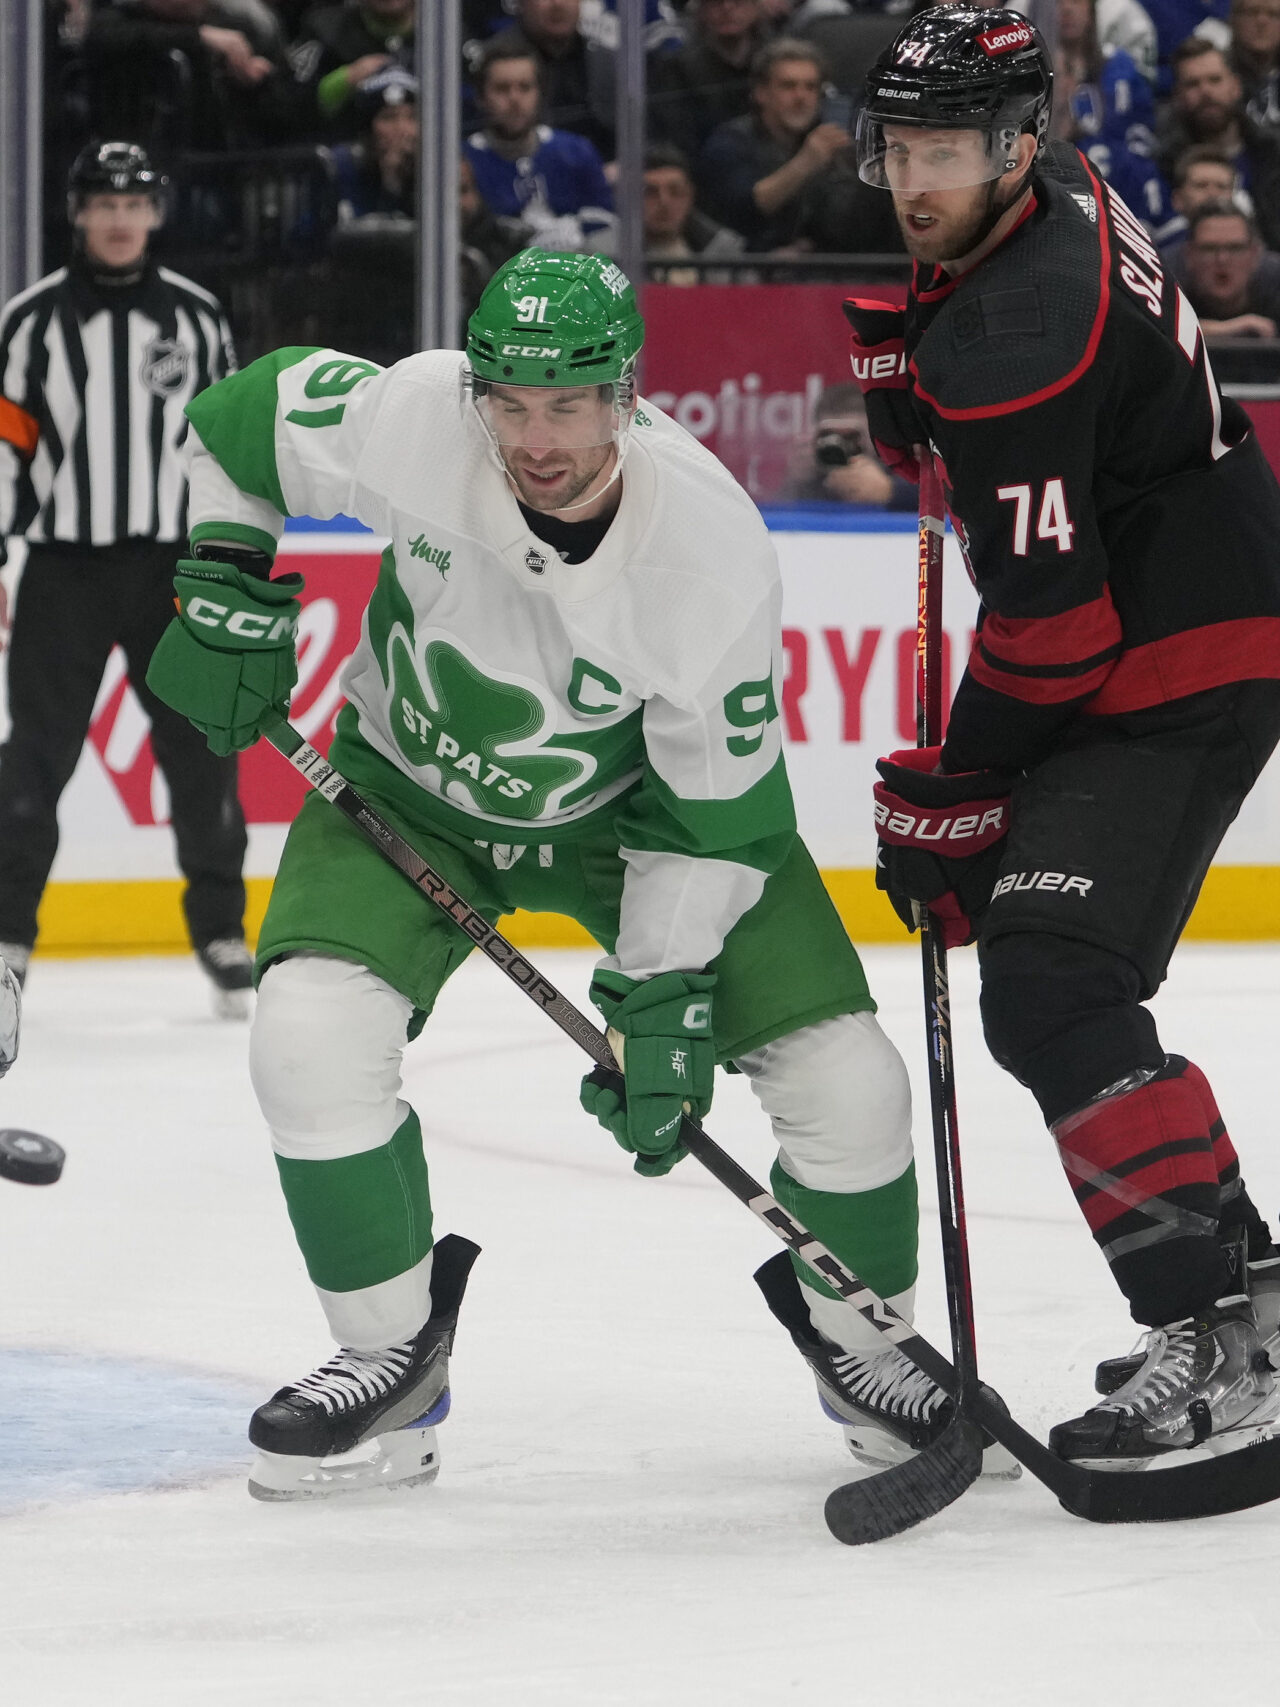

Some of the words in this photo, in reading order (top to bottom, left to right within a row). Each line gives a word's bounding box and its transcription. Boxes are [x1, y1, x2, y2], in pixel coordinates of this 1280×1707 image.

[896, 40, 934, 68] 74
[983, 28, 1031, 51] Lenovo
[877, 87, 921, 101] BAUER
[516, 295, 550, 324] 91
[501, 344, 561, 360] CCM
[284, 359, 381, 429] 91
[995, 475, 1076, 557] 74
[407, 533, 452, 583] Milk
[186, 596, 299, 641] CCM
[567, 656, 623, 715] C
[434, 731, 533, 799] PATS
[360, 808, 394, 842] NANOLITE
[875, 800, 1004, 840] BAUER
[989, 871, 1094, 904] BAUER
[416, 867, 558, 1008] RIBCOR
[558, 1003, 613, 1058] TRIGGER
[654, 1109, 683, 1137] CCM
[748, 1192, 919, 1346] CCM
